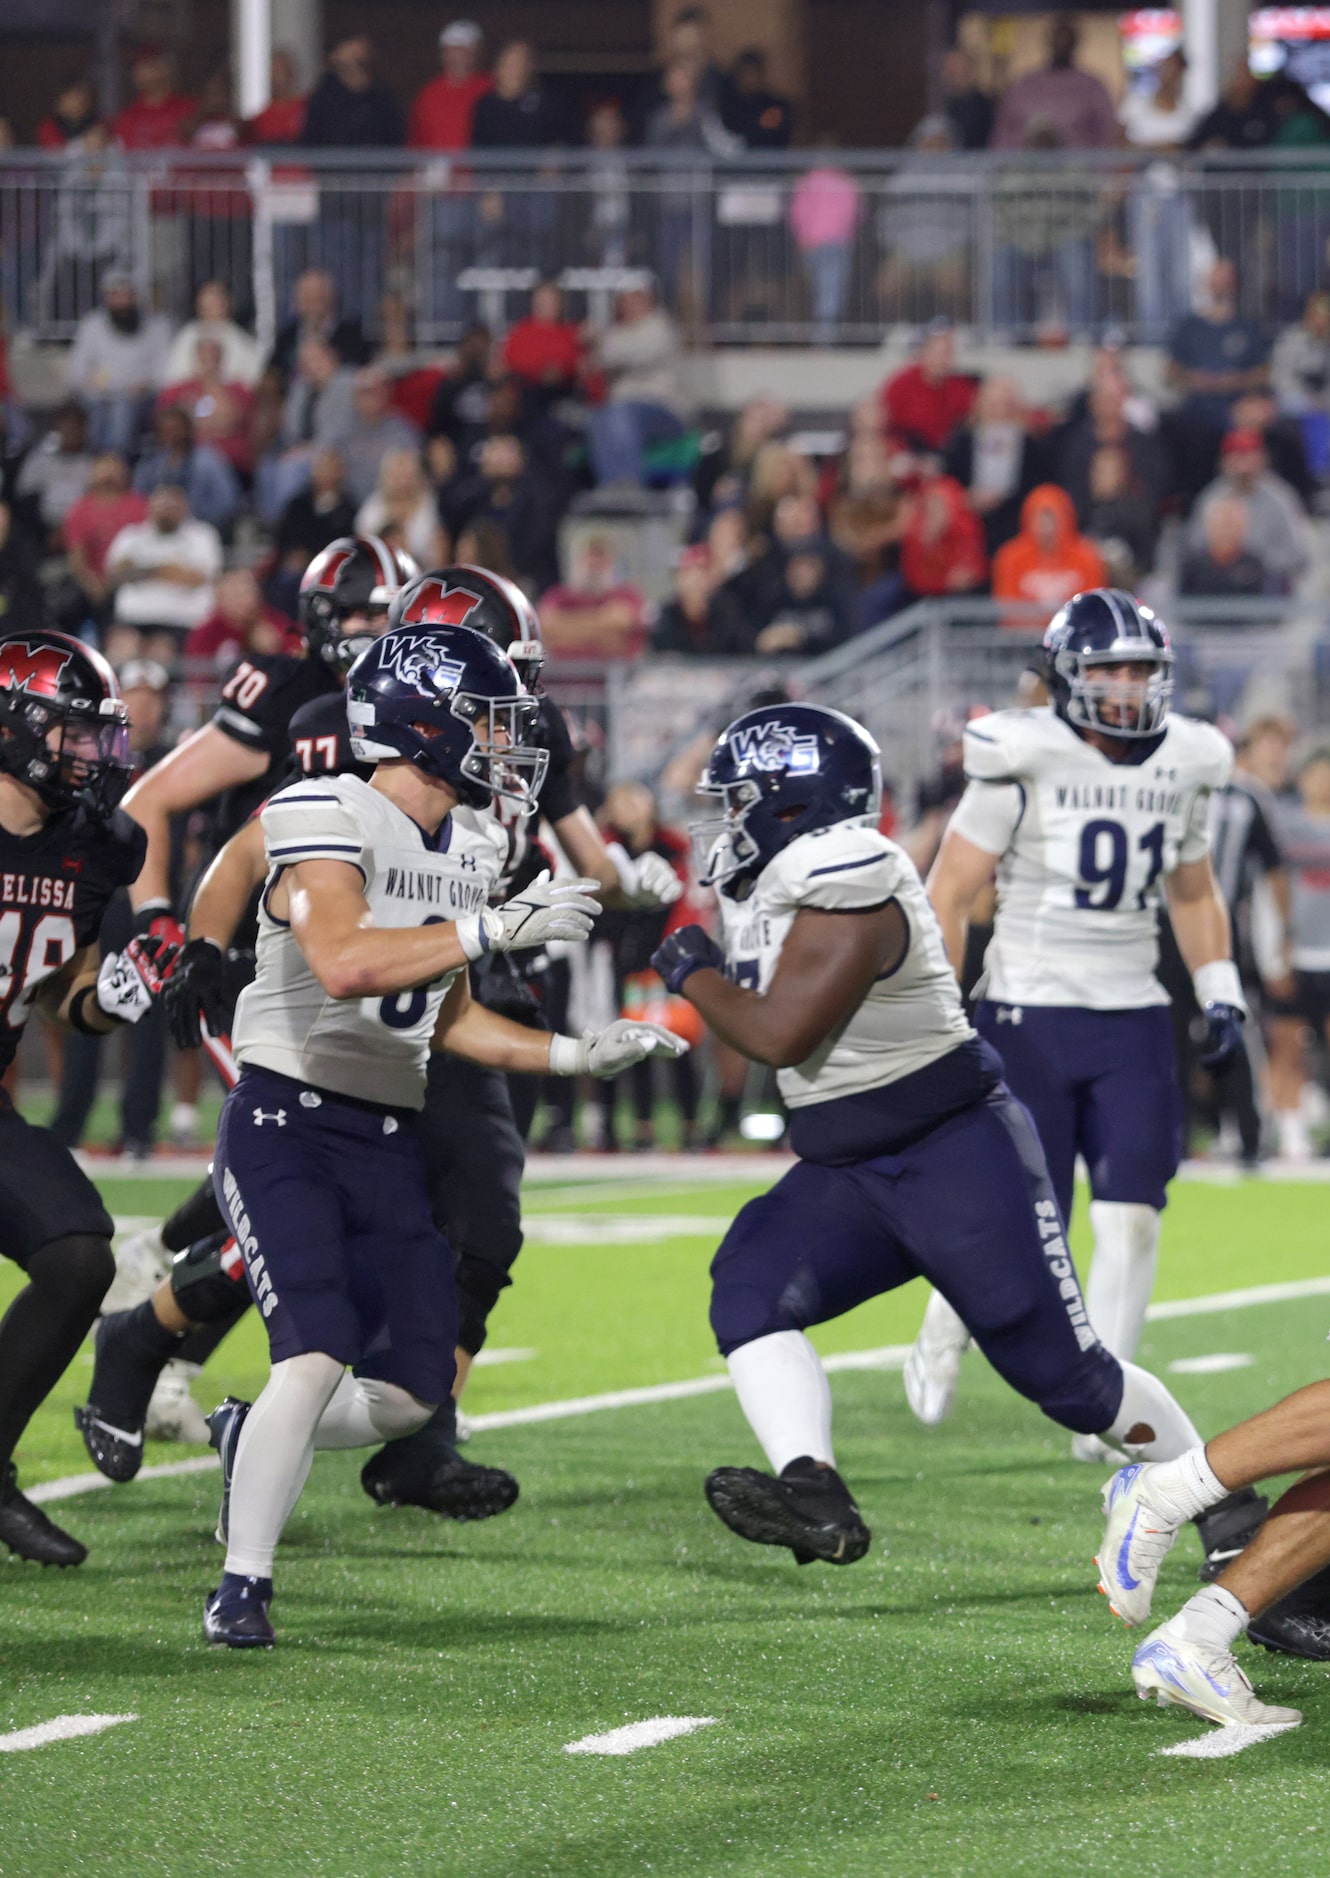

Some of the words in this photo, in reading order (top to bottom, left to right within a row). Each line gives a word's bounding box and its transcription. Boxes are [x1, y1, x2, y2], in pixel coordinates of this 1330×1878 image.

[402, 577, 483, 625] M
[0, 640, 74, 700] M
[222, 661, 269, 710] 70
[295, 735, 338, 772] 77
[1056, 784, 1128, 811] WALNUT
[1136, 787, 1182, 815] GROVE
[385, 867, 442, 904] WALNUT
[1074, 818, 1165, 911] 91
[0, 873, 76, 911] ELISSA
[222, 1166, 279, 1318] WILDCATS
[1034, 1199, 1097, 1353] WILDCATS
